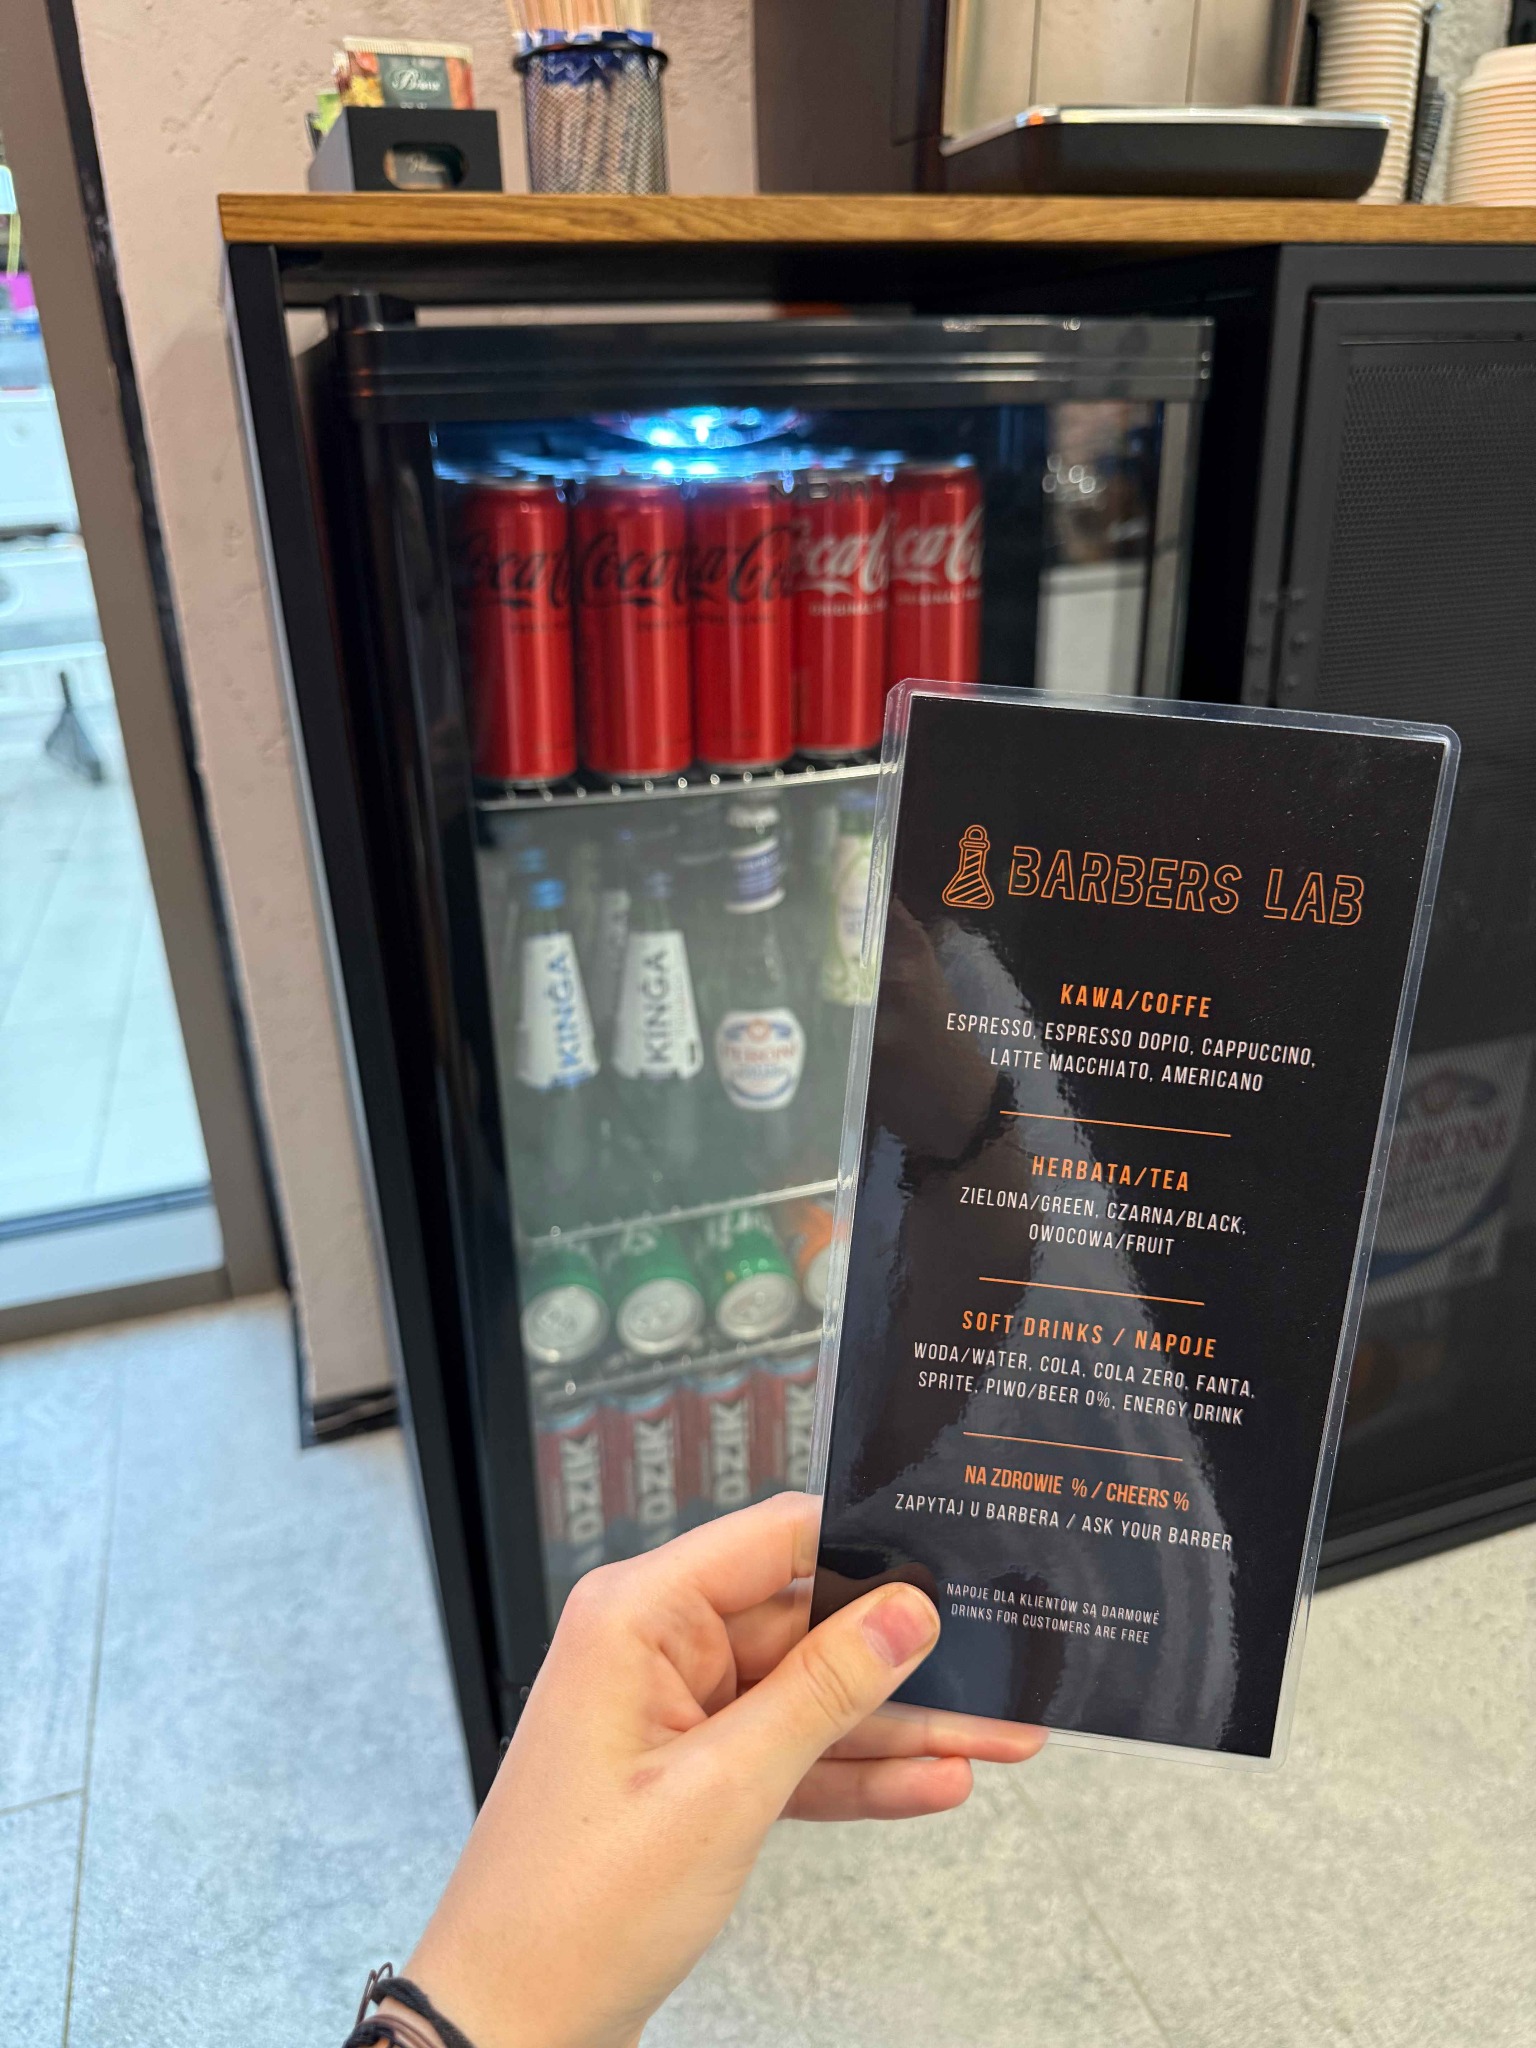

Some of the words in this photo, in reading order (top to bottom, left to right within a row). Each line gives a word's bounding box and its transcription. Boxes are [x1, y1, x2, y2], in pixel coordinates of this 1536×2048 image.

[1007, 844, 1242, 914] BARBERS
[1263, 867, 1364, 926] LAB
[546, 952, 581, 1067] KINGA
[642, 951, 672, 1064] KINGA
[1059, 982, 1211, 1018] KAWA/COFFE
[946, 1012, 1036, 1039] ESPRESSO,
[1044, 1021, 1132, 1048] ESPRESSO
[1138, 1030, 1193, 1055] DOPIO,
[1201, 1037, 1315, 1068] CAPPUCCINO,
[990, 1047, 1044, 1069] LATTE
[1049, 1052, 1153, 1082] MACCHIATO,
[1160, 1064, 1263, 1091] AMERICANO
[1031, 1155, 1188, 1191] HERBATA/TEA
[959, 1186, 1098, 1218] ZIELONA/GREEN,
[1106, 1201, 1246, 1235] CZARNA/BLACK,
[1028, 1223, 1175, 1255] OWOCOWA/FRUIT
[961, 1310, 1014, 1334] SOFT
[1023, 1316, 1103, 1344] DRINKS
[1134, 1329, 1216, 1358] NAPOJE
[914, 1341, 1032, 1371] WODA/WATER,
[1039, 1355, 1085, 1378] COLA,
[1093, 1361, 1134, 1382] COLA
[1141, 1367, 1188, 1391] ZERO,
[1195, 1374, 1254, 1398] FANTA,
[918, 1370, 977, 1393] SPRITE,
[985, 1377, 1079, 1404] PIWO/BEER
[1123, 1394, 1188, 1417] ENERGY
[1193, 1402, 1243, 1425] DRINK
[964, 1464, 986, 1485] NA
[989, 1467, 1063, 1494] ZDROWIE
[1105, 1482, 1169, 1509] CHEERS
[894, 1493, 963, 1515] ZAPYTAJ
[970, 1500, 979, 1517] U
[985, 1502, 1058, 1528] BARBERA
[1081, 1515, 1113, 1535] ASK
[1121, 1519, 1162, 1542] YOUR
[1167, 1526, 1232, 1552] BARBER
[946, 1582, 989, 1600] NAPOJE
[993, 1588, 1015, 1604] DLA
[1019, 1592, 1078, 1614] KLIENTÓW
[1082, 1602, 1096, 1618] SĄ
[1101, 1604, 1159, 1625] DARMOWE
[950, 1603, 992, 1620] DRINKS
[996, 1609, 1018, 1625] FOR
[1022, 1613, 1090, 1635] CUSTOMERS
[1094, 1624, 1117, 1639] ARE
[1120, 1627, 1149, 1643] FREE
